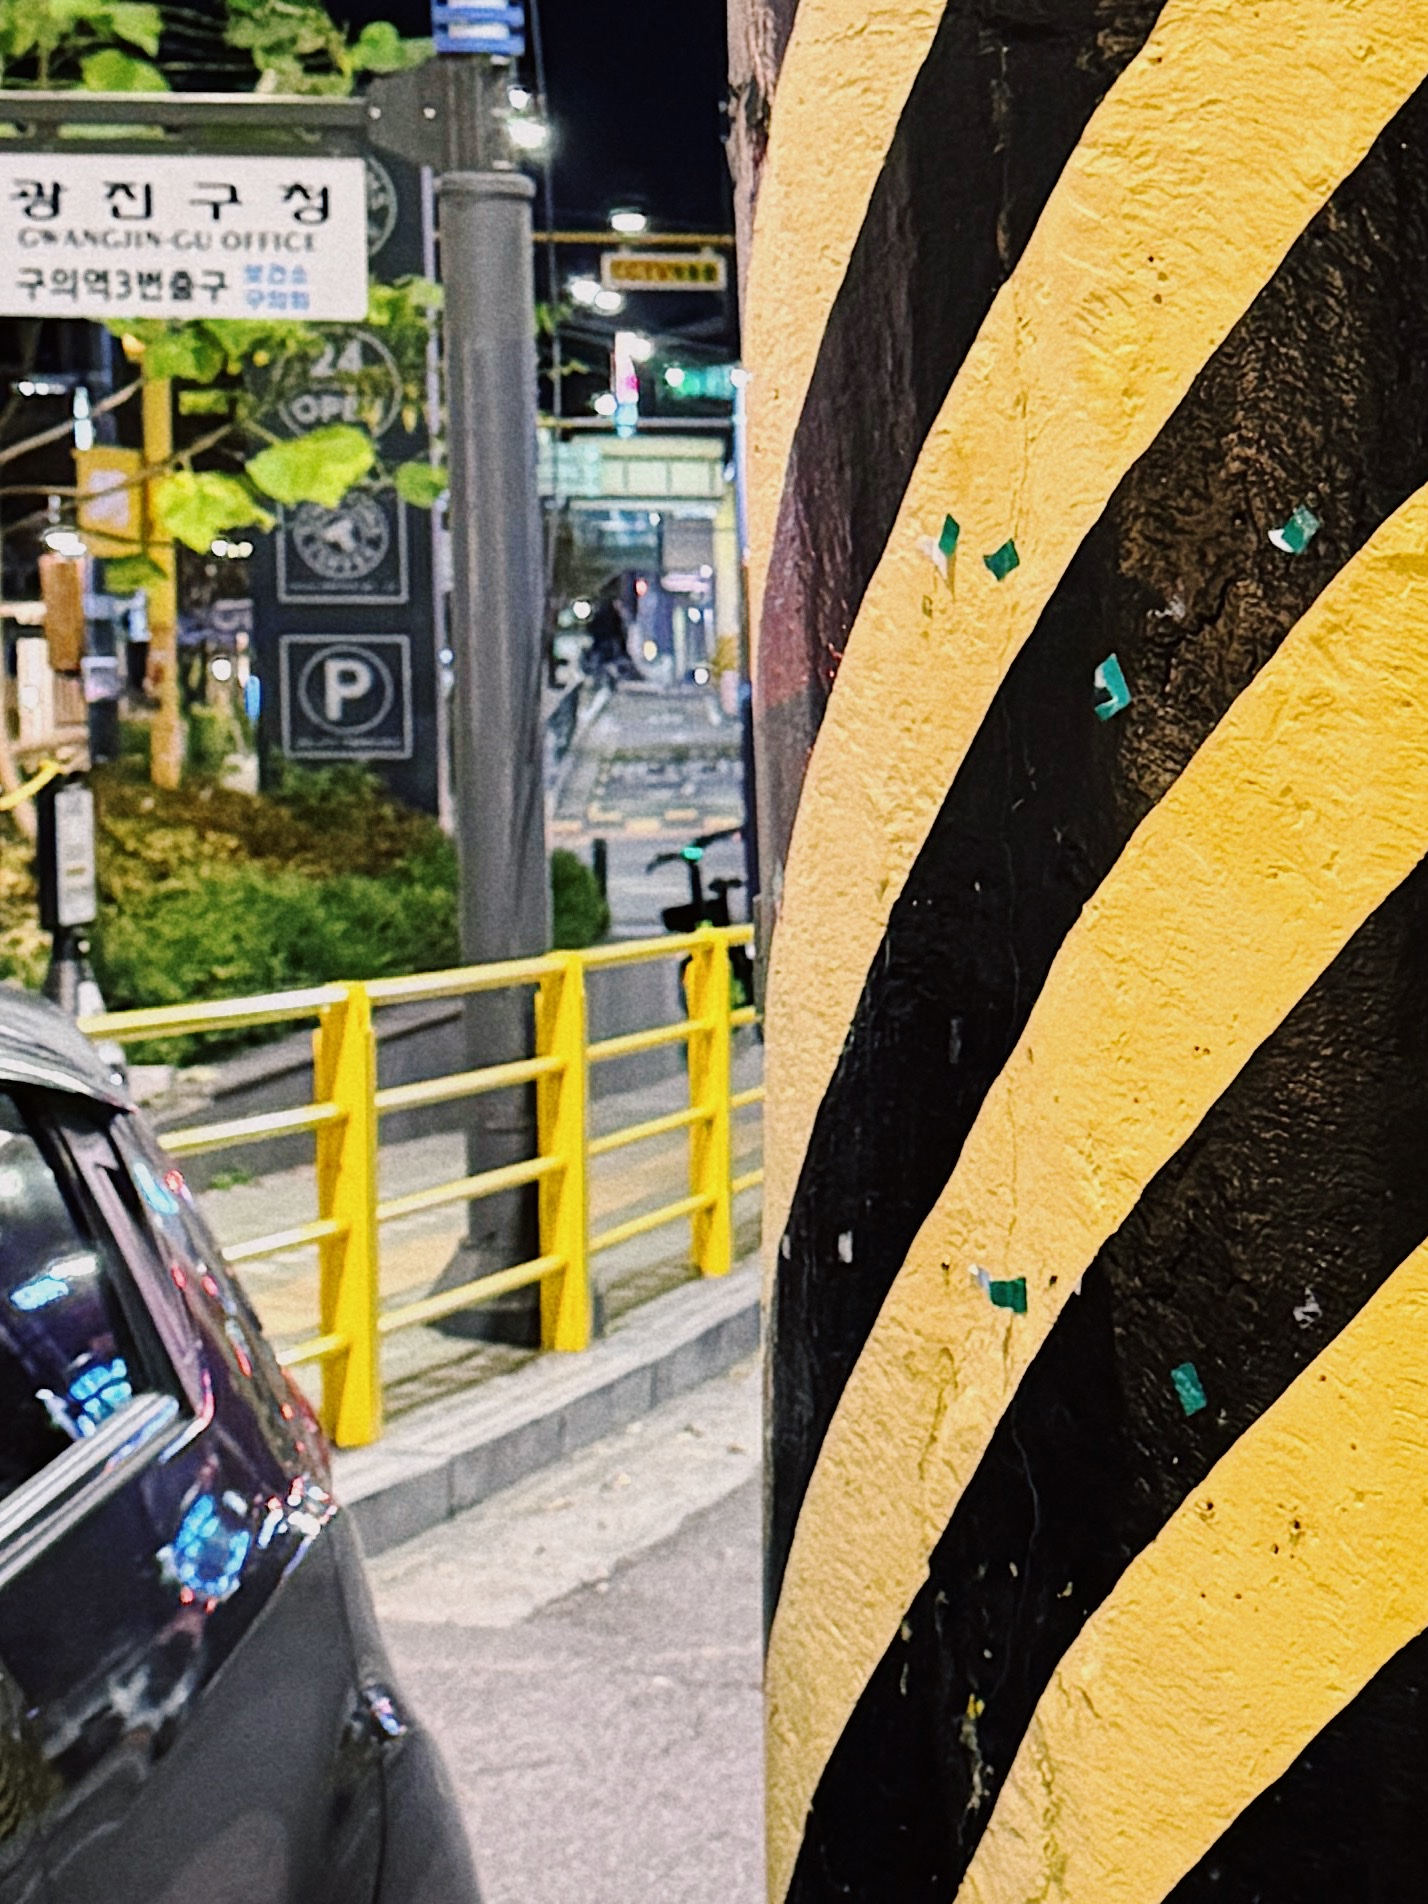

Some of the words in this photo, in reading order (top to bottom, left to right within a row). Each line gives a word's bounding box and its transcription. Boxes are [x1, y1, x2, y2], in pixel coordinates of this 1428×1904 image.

[12, 179, 329, 225] 광진구청
[17, 227, 213, 250] GWANGJIN-GU
[219, 228, 315, 251] OFFICE
[16, 267, 229, 303] 구의역3번출구
[324, 657, 376, 722] P
